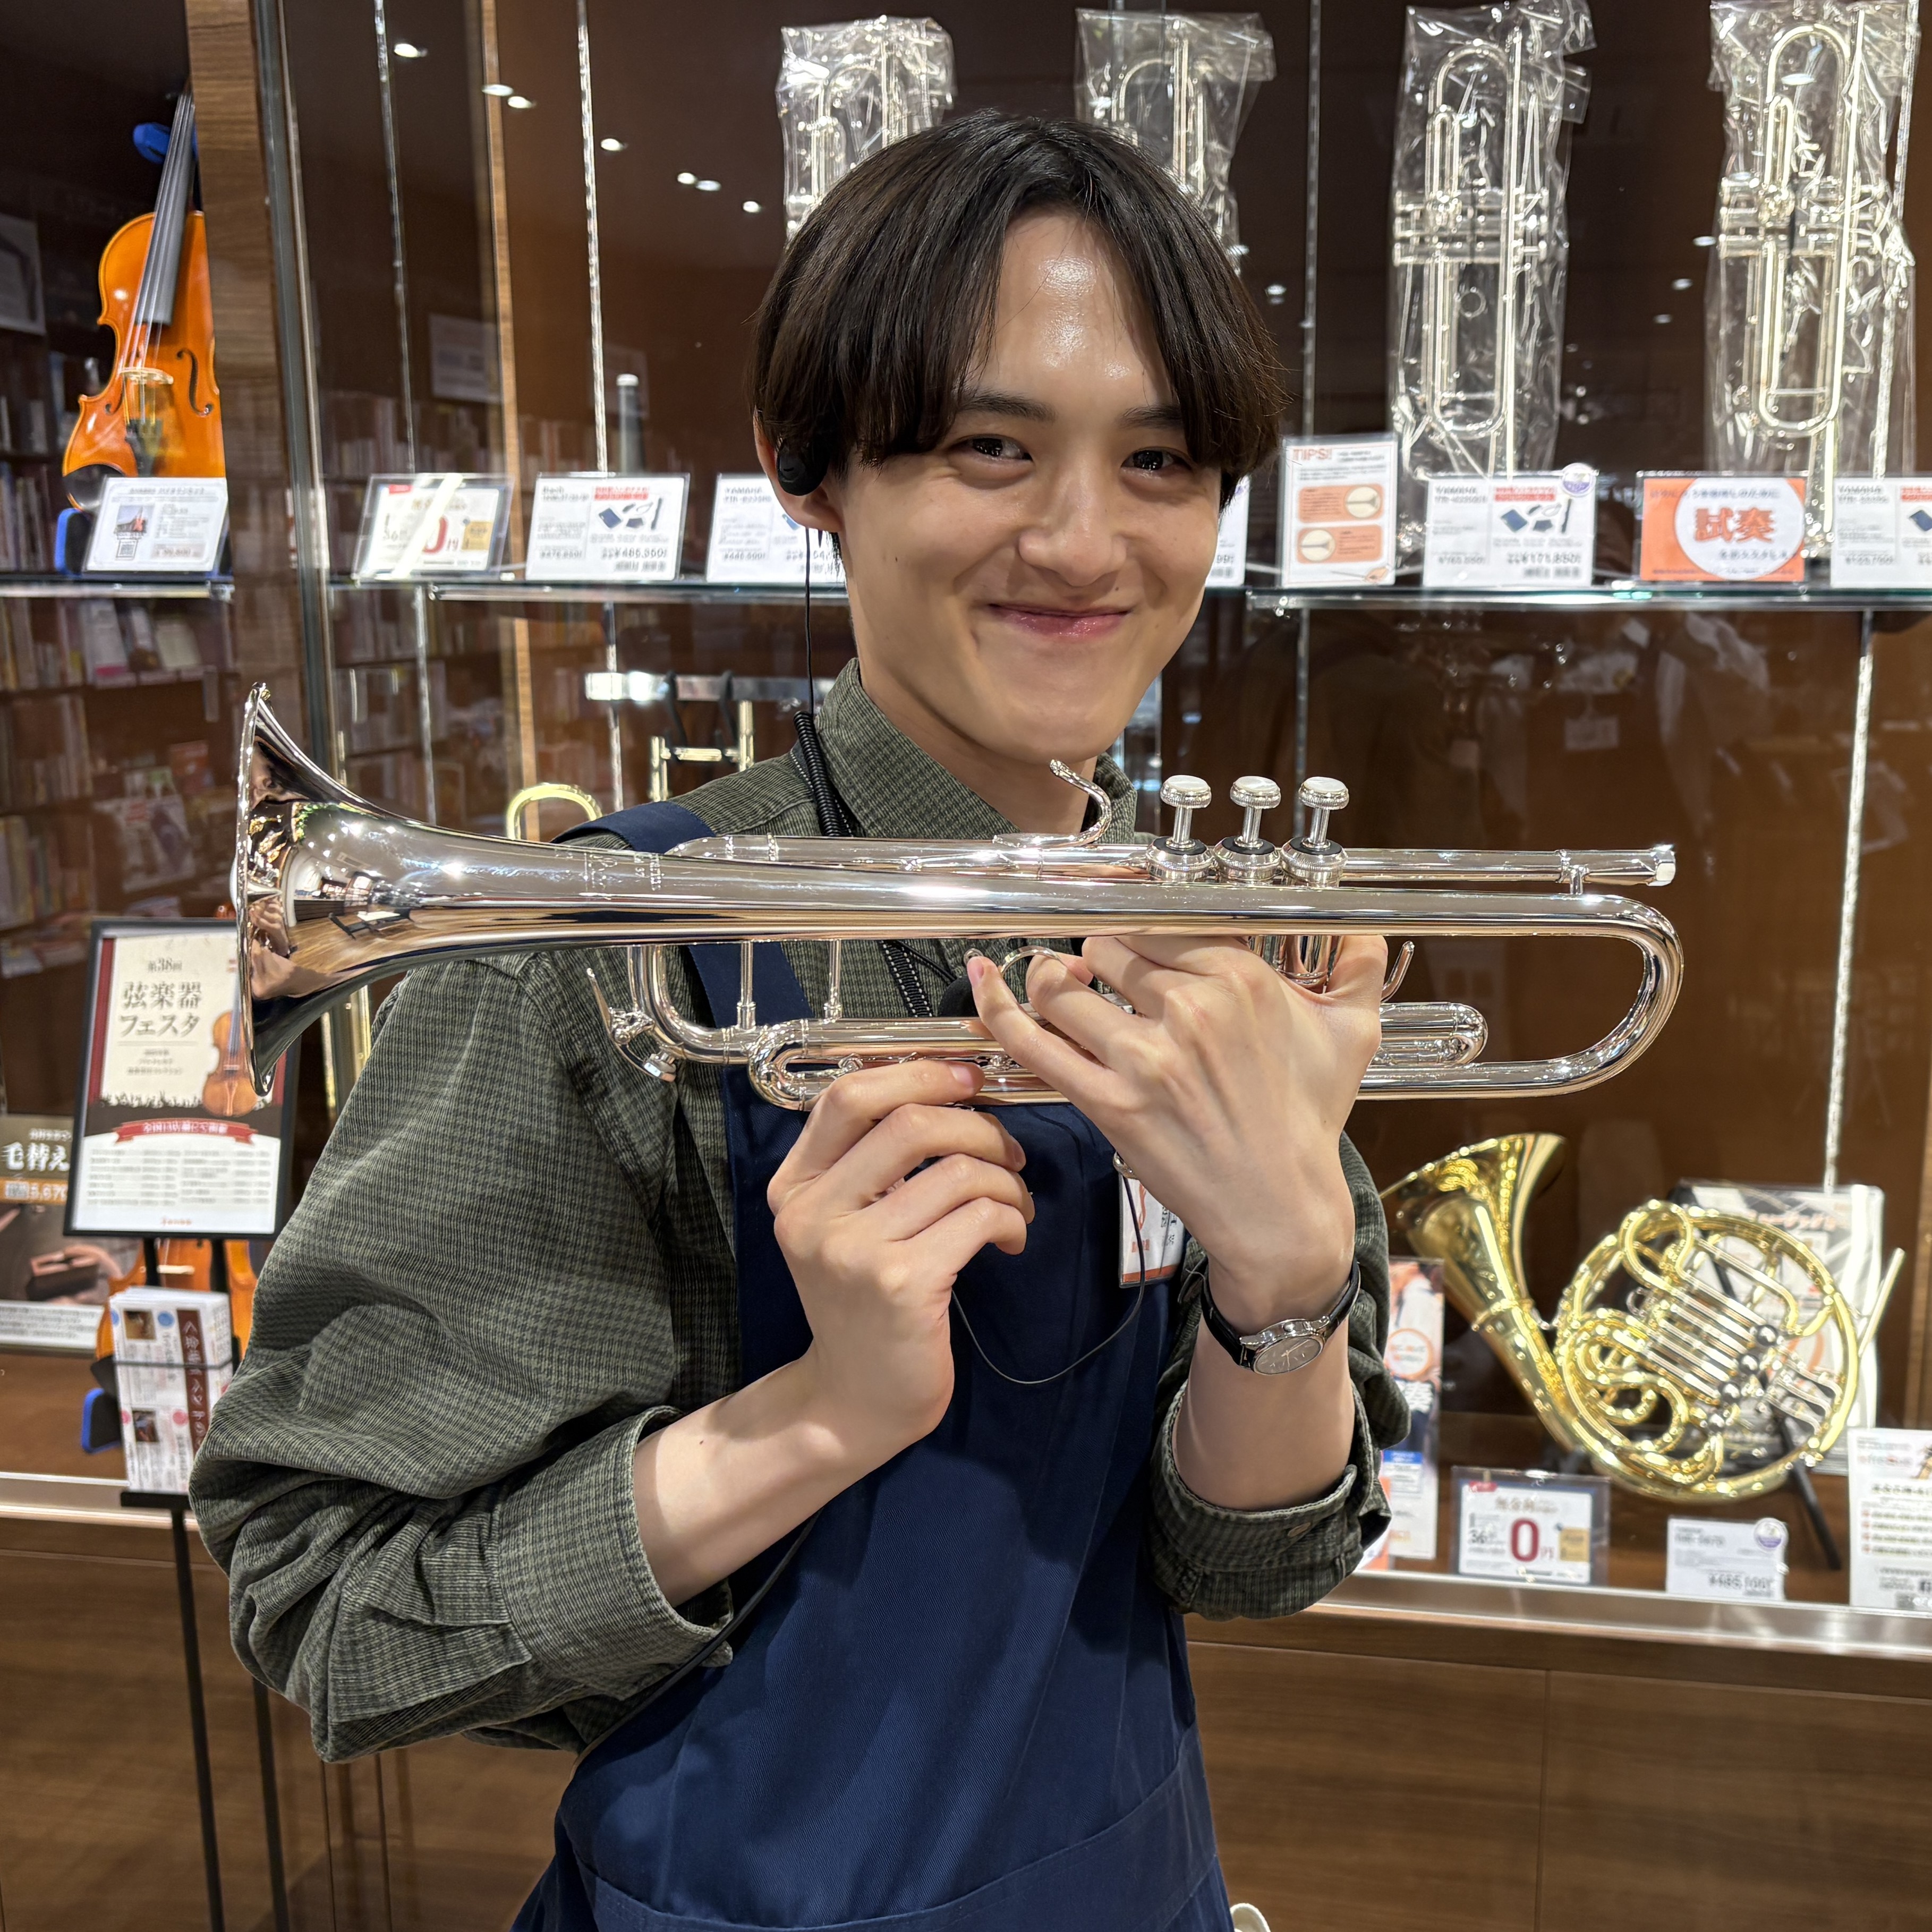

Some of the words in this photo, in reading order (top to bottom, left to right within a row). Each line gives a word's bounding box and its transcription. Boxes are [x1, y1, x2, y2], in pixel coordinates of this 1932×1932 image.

[1695, 508, 1775, 543] 試奏
[123, 982, 201, 1009] 弦楽器
[119, 1012, 200, 1037] フェスタ
[1, 1142, 70, 1171] 毛替え
